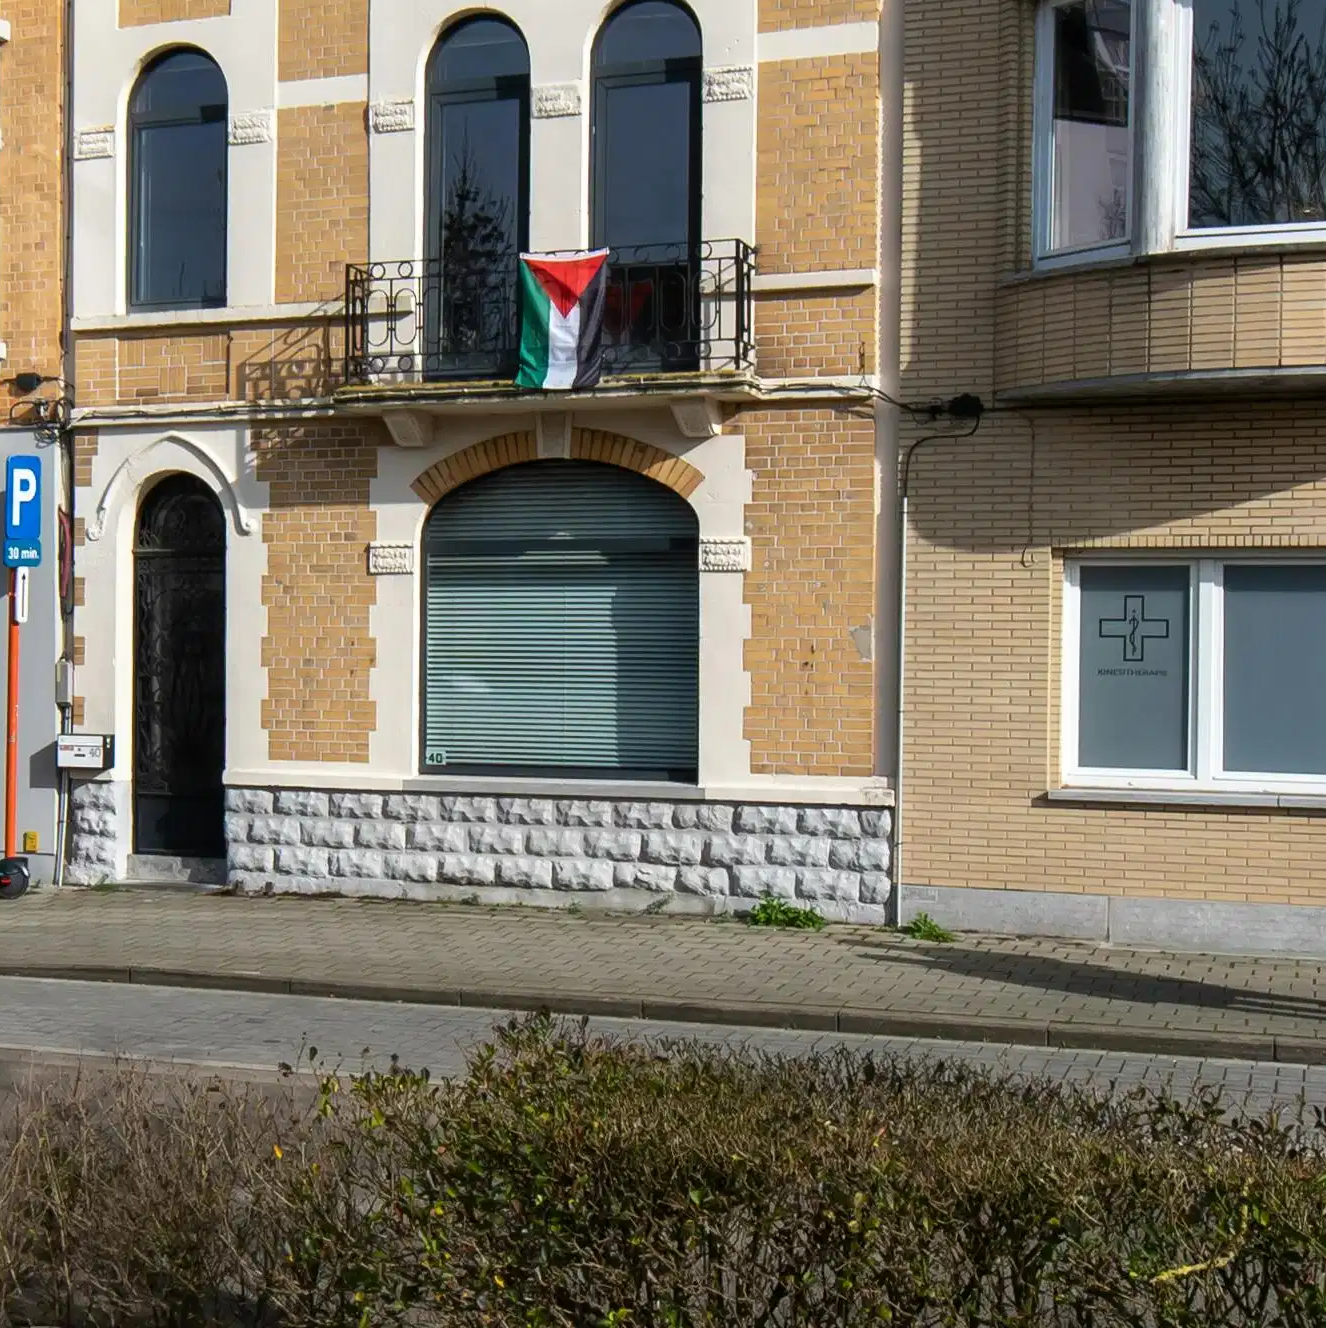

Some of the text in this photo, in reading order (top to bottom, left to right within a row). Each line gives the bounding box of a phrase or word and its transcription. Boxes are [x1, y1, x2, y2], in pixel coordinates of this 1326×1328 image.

[11, 468, 37, 526] P
[7, 546, 40, 560] 30 min.
[88, 747, 102, 759] 40
[428, 752, 443, 764] 40
